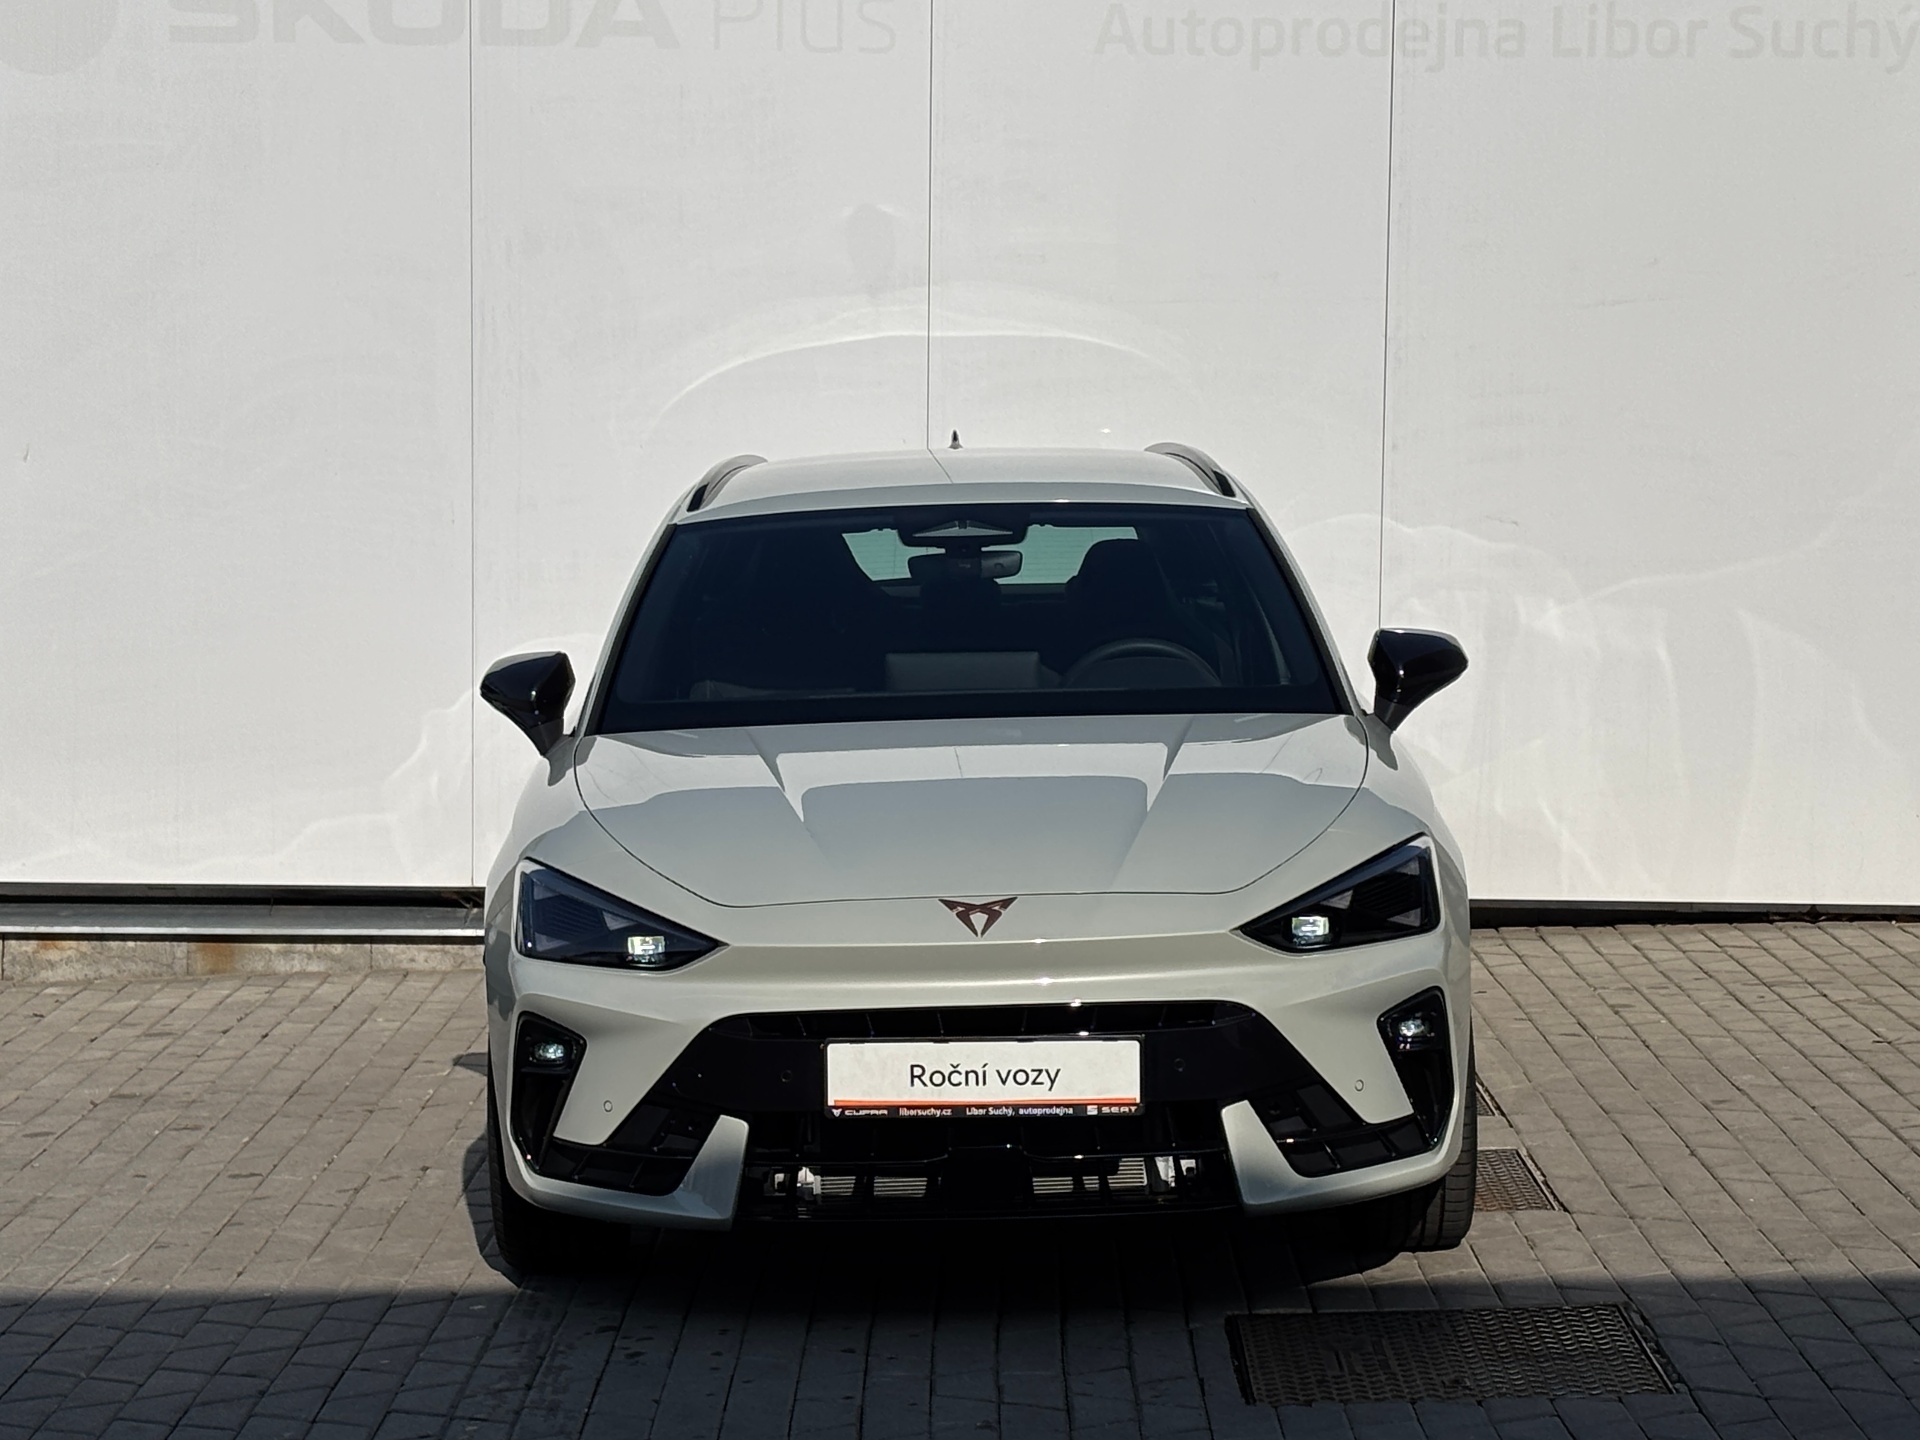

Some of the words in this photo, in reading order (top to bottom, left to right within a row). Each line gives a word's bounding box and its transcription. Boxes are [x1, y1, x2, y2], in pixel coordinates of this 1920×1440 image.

[1094, 0, 1526, 73] Autoprodejna
[1552, 0, 1709, 59] Libor
[1728, 0, 1920, 75] Suchý
[909, 1062, 989, 1087] Roční
[995, 1068, 1062, 1091] vozy
[899, 1107, 952, 1117] liborsuchy.cz
[965, 1106, 987, 1115] Libor
[1018, 1106, 1074, 1116] autoprodejna
[1101, 1105, 1138, 1114] SEAT
